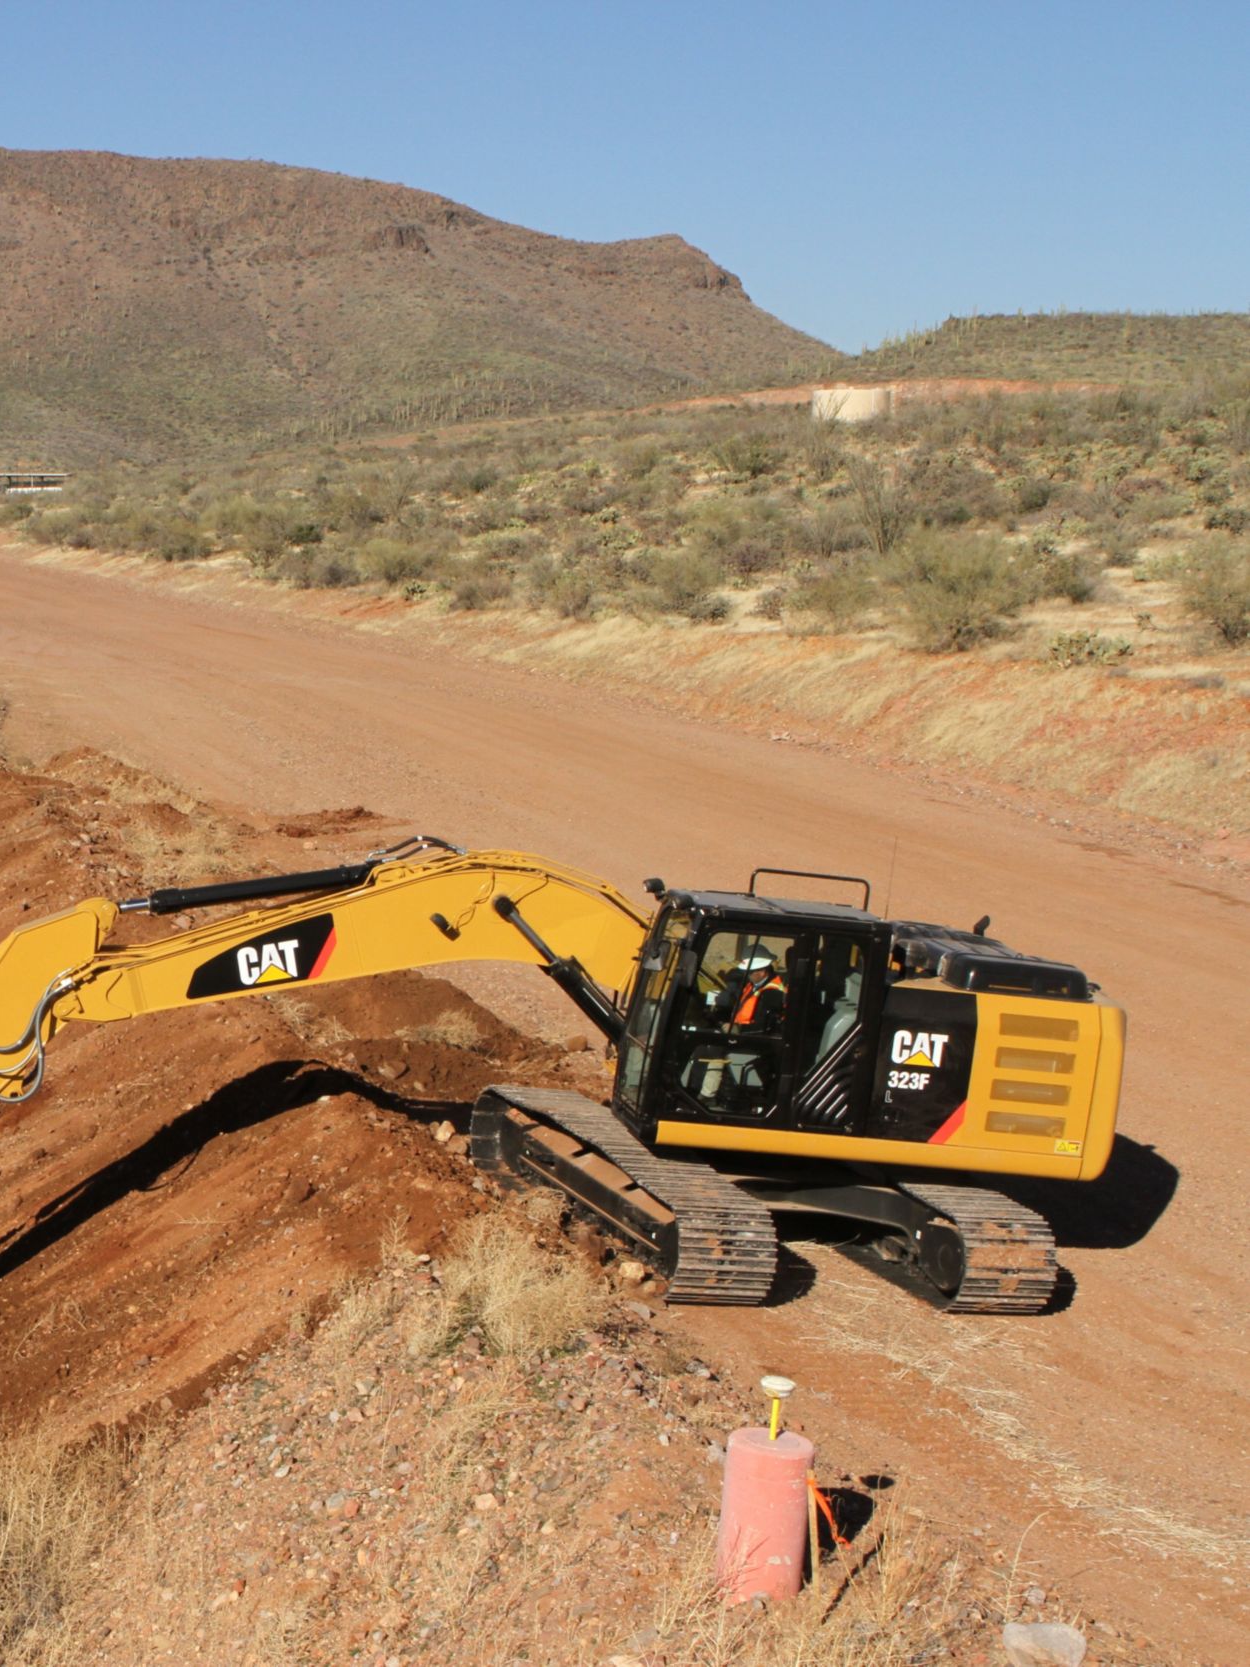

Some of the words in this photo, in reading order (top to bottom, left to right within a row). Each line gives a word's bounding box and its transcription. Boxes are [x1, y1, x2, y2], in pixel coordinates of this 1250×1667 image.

[236, 939, 299, 986] CAT
[891, 1029, 949, 1068] CAT
[887, 1070, 930, 1091] 323F
[884, 1089, 893, 1103] L
